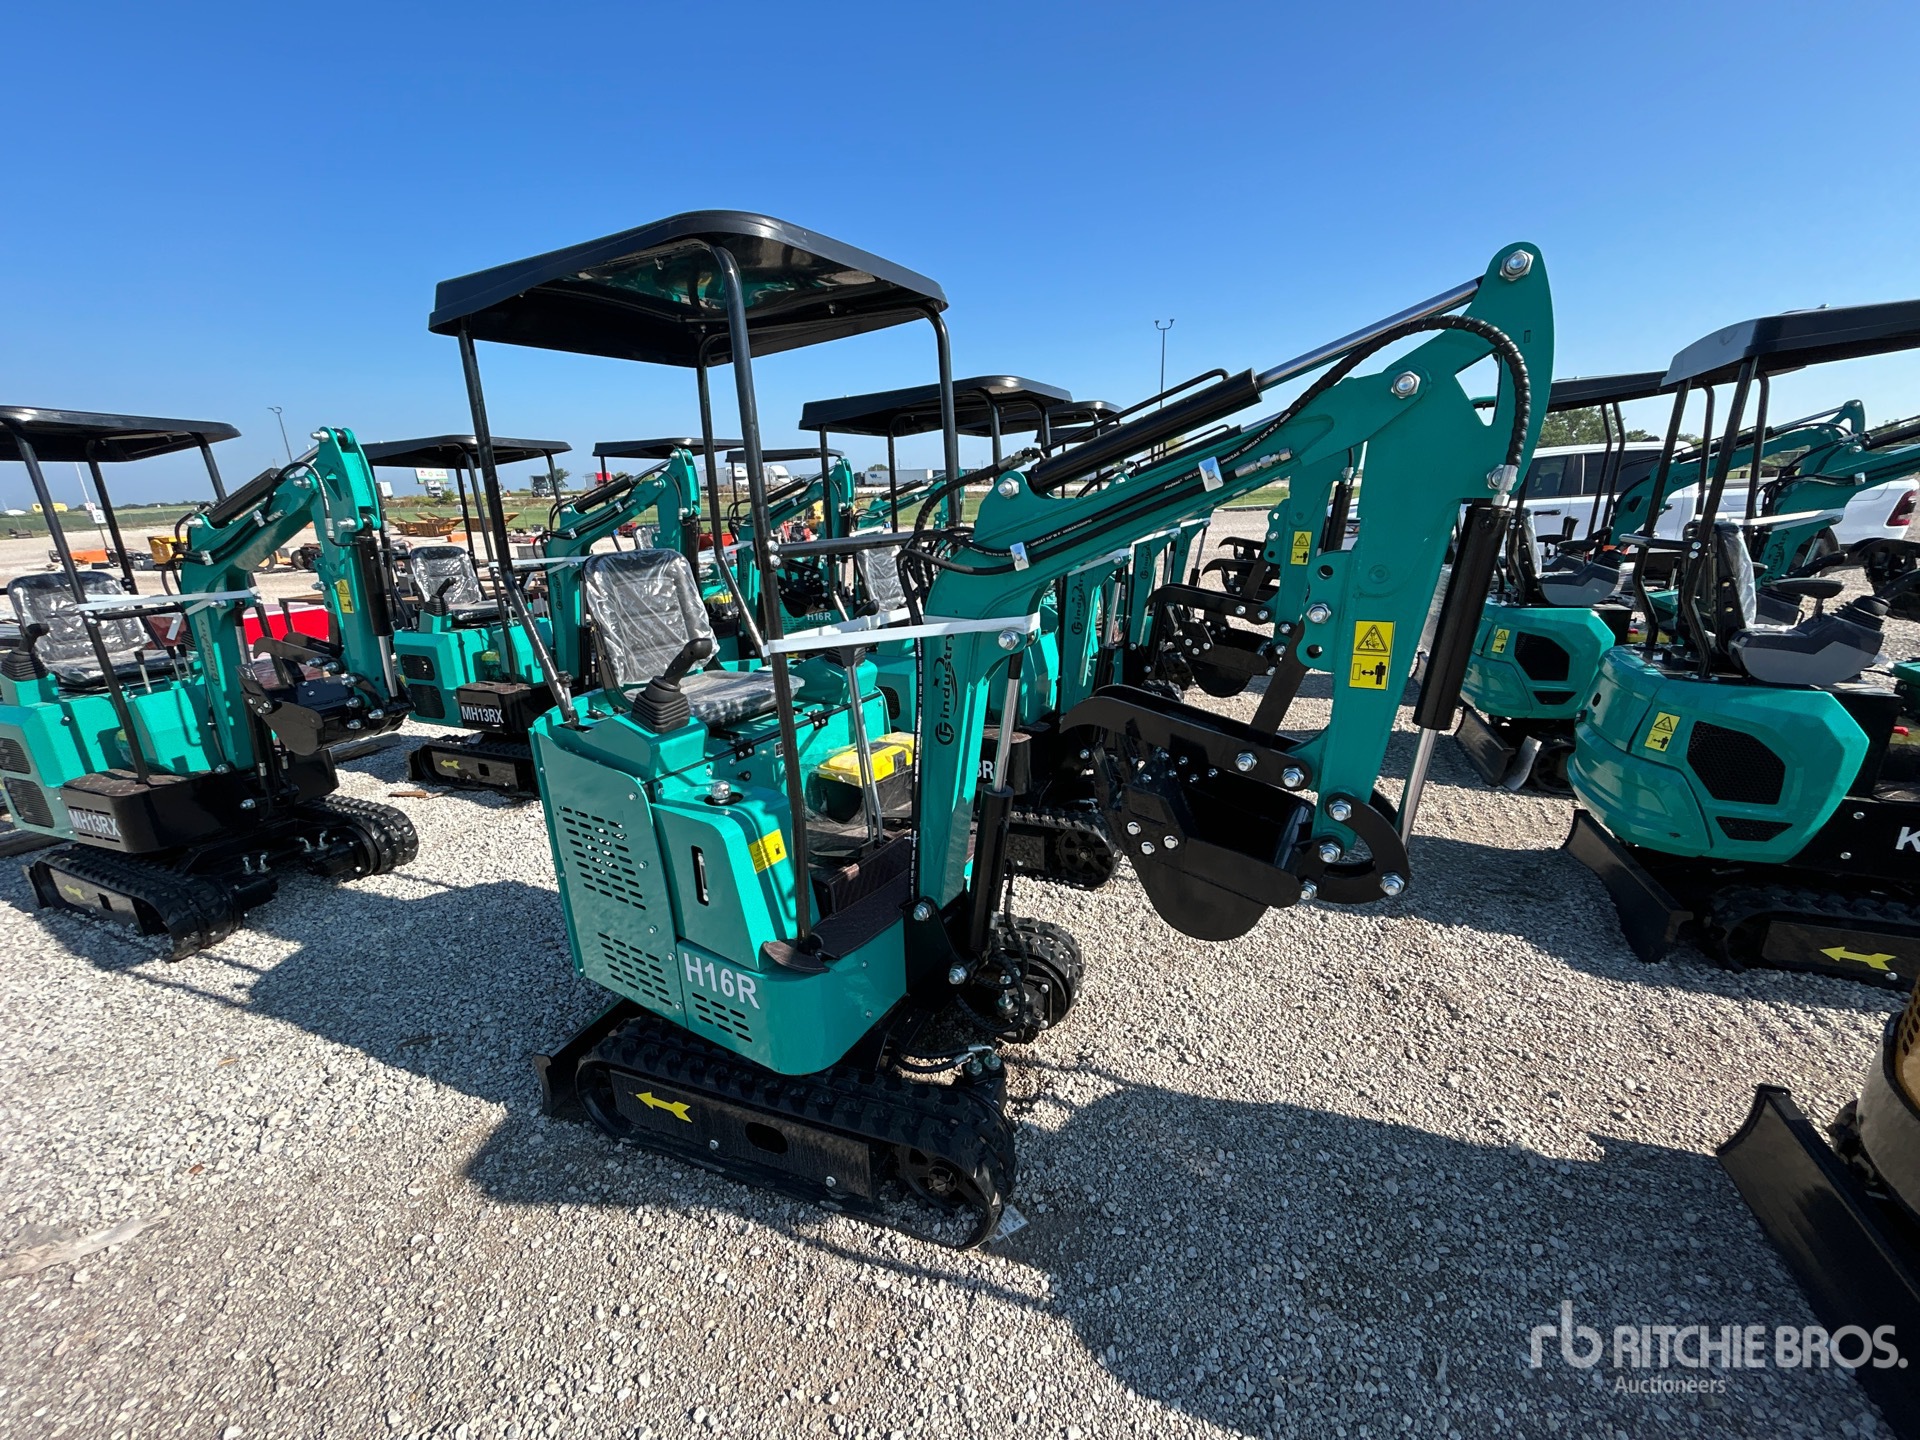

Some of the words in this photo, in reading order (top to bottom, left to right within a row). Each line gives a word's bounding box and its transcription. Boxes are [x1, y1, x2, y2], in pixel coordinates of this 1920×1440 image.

[807, 612, 832, 621] H16R
[461, 705, 505, 724] MH13RX
[68, 809, 122, 837] MH13RX
[683, 952, 760, 1010] H16R
